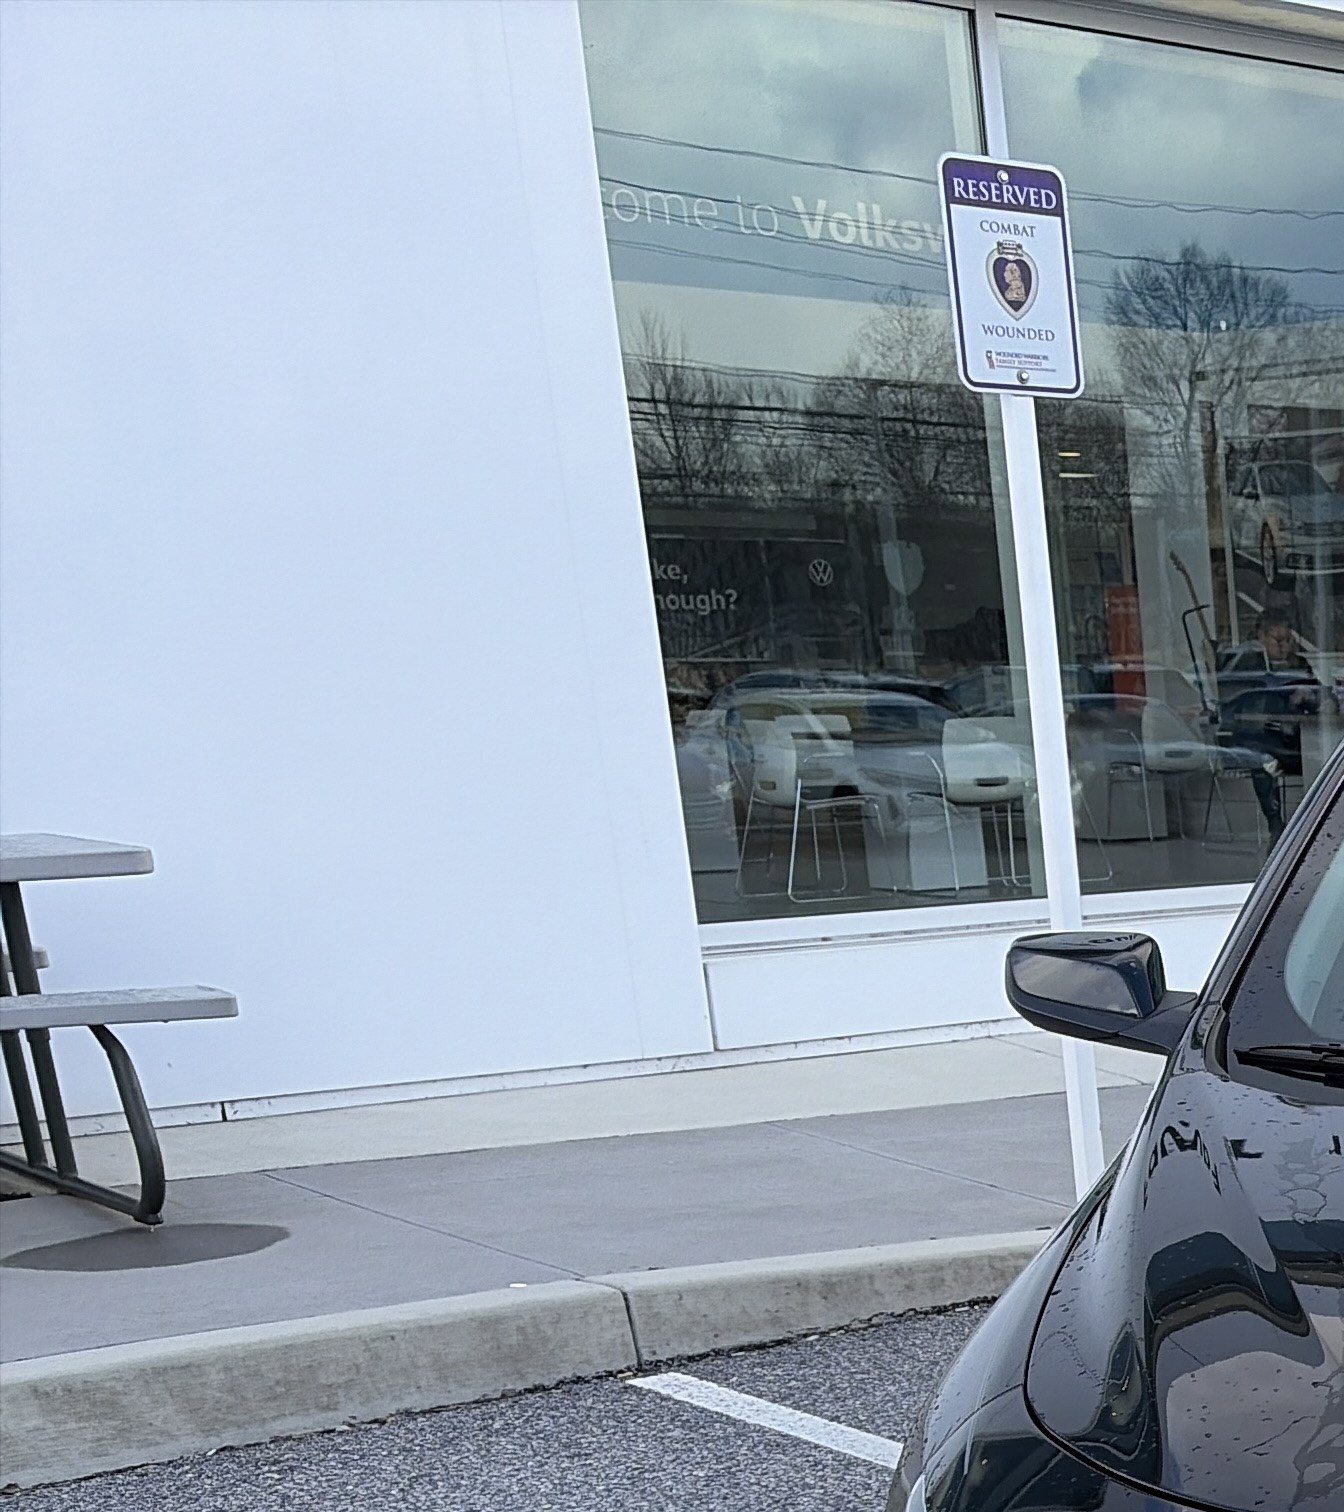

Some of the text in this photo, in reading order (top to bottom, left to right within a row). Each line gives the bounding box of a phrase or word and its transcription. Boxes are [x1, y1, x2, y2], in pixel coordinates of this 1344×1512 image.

[953, 177, 1057, 210] RESERVED
[601, 186, 718, 230] ome
[737, 195, 779, 236] to
[980, 220, 1036, 237] COMBAT
[981, 324, 1055, 341] WOUNDED
